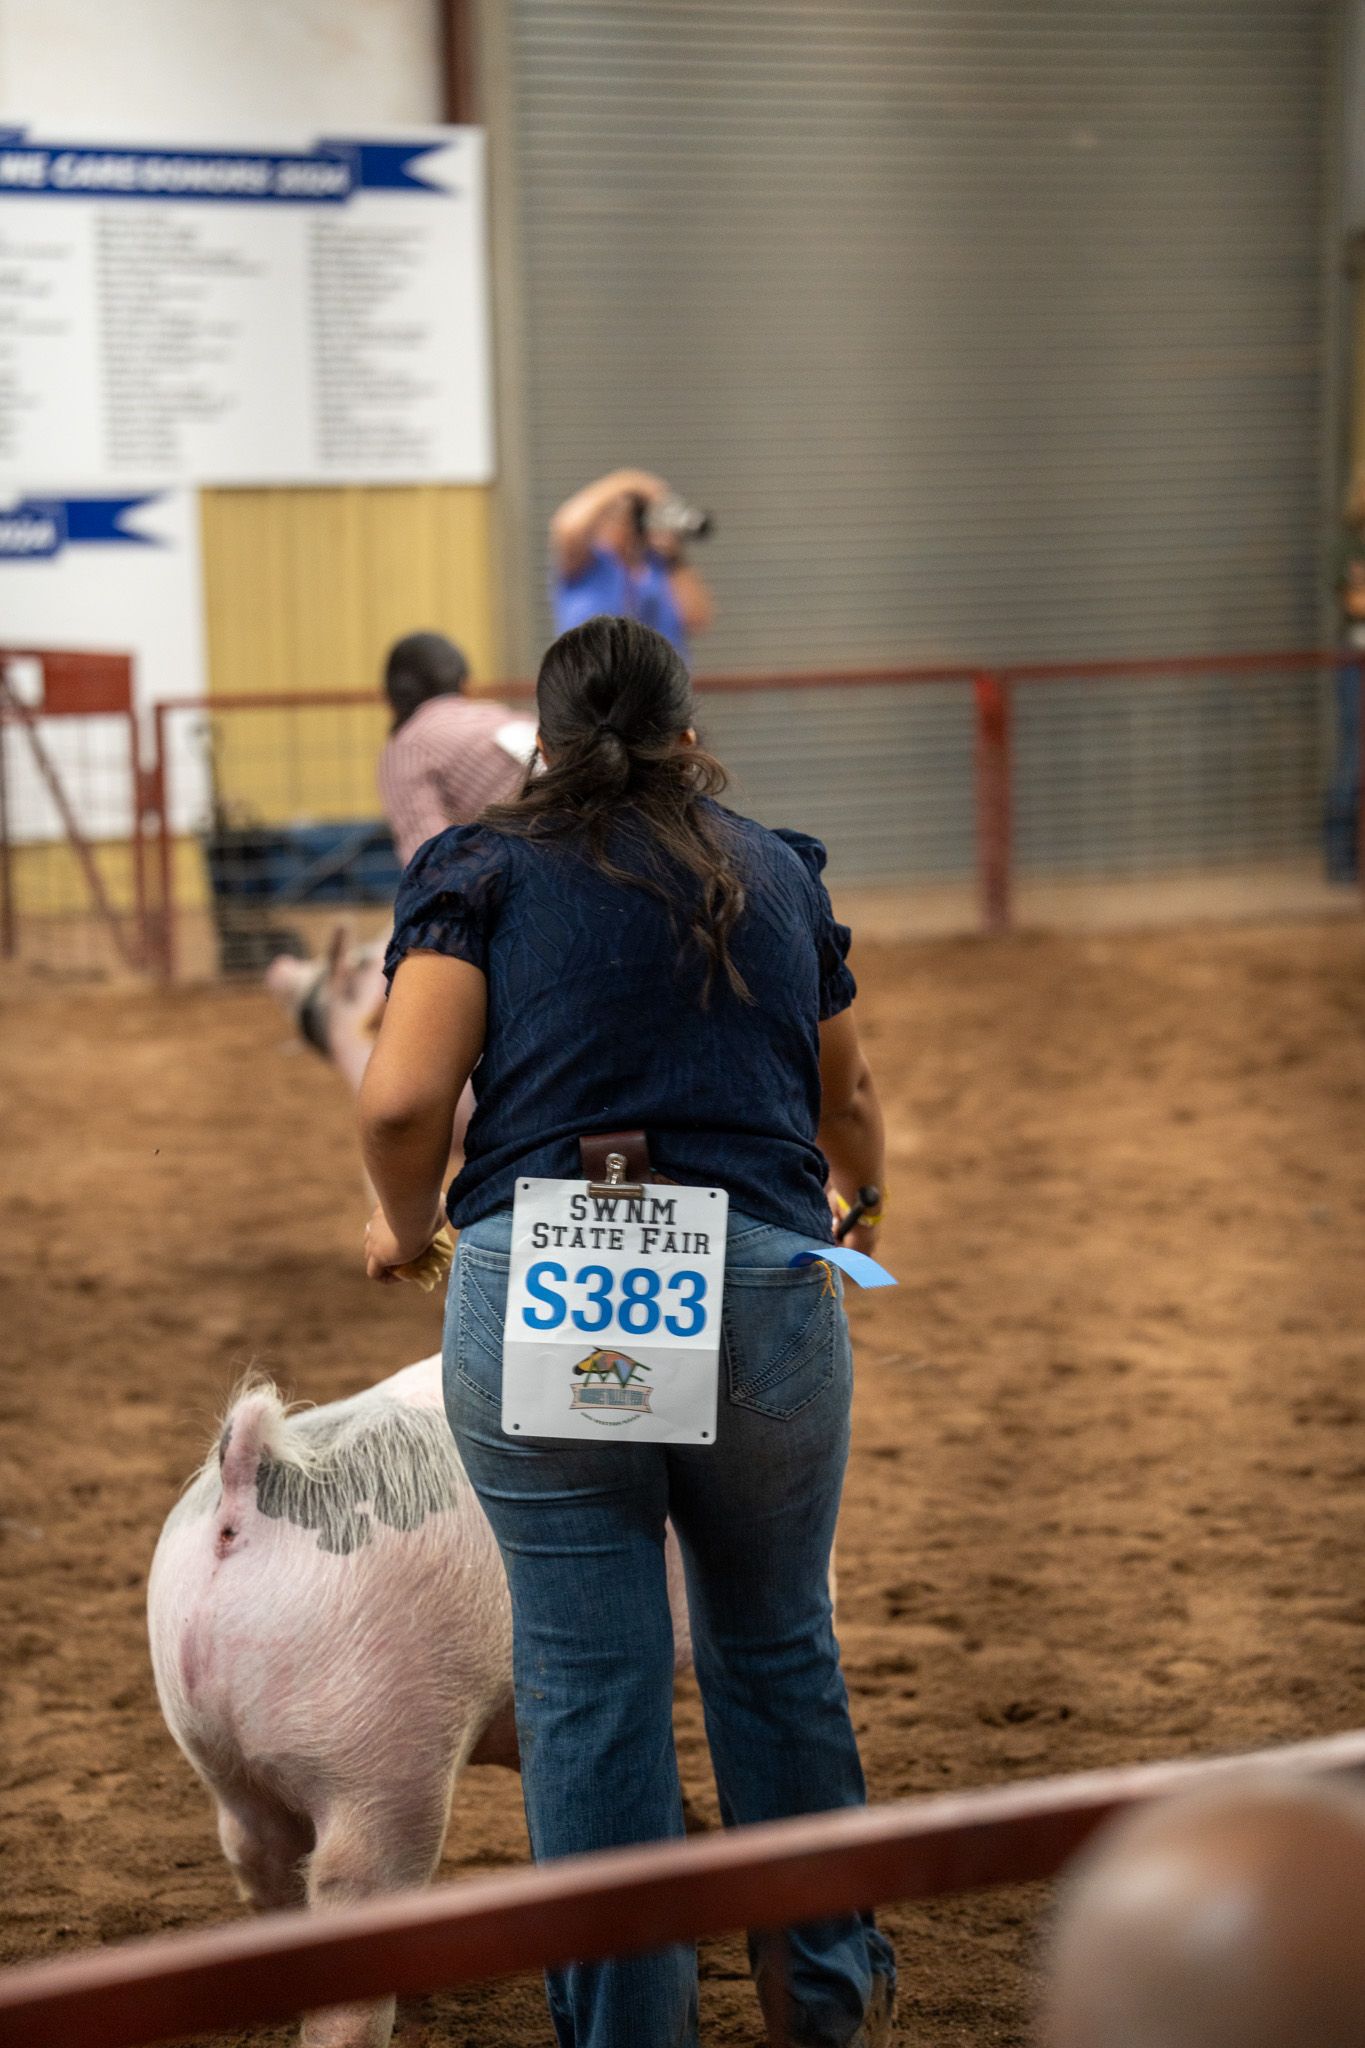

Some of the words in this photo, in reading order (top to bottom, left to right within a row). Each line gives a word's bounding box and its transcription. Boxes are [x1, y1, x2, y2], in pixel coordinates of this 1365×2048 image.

[571, 1194, 676, 1225] SWNM
[532, 1223, 624, 1250] STATE
[639, 1227, 711, 1254] FAIR
[522, 1261, 707, 1337] S383
